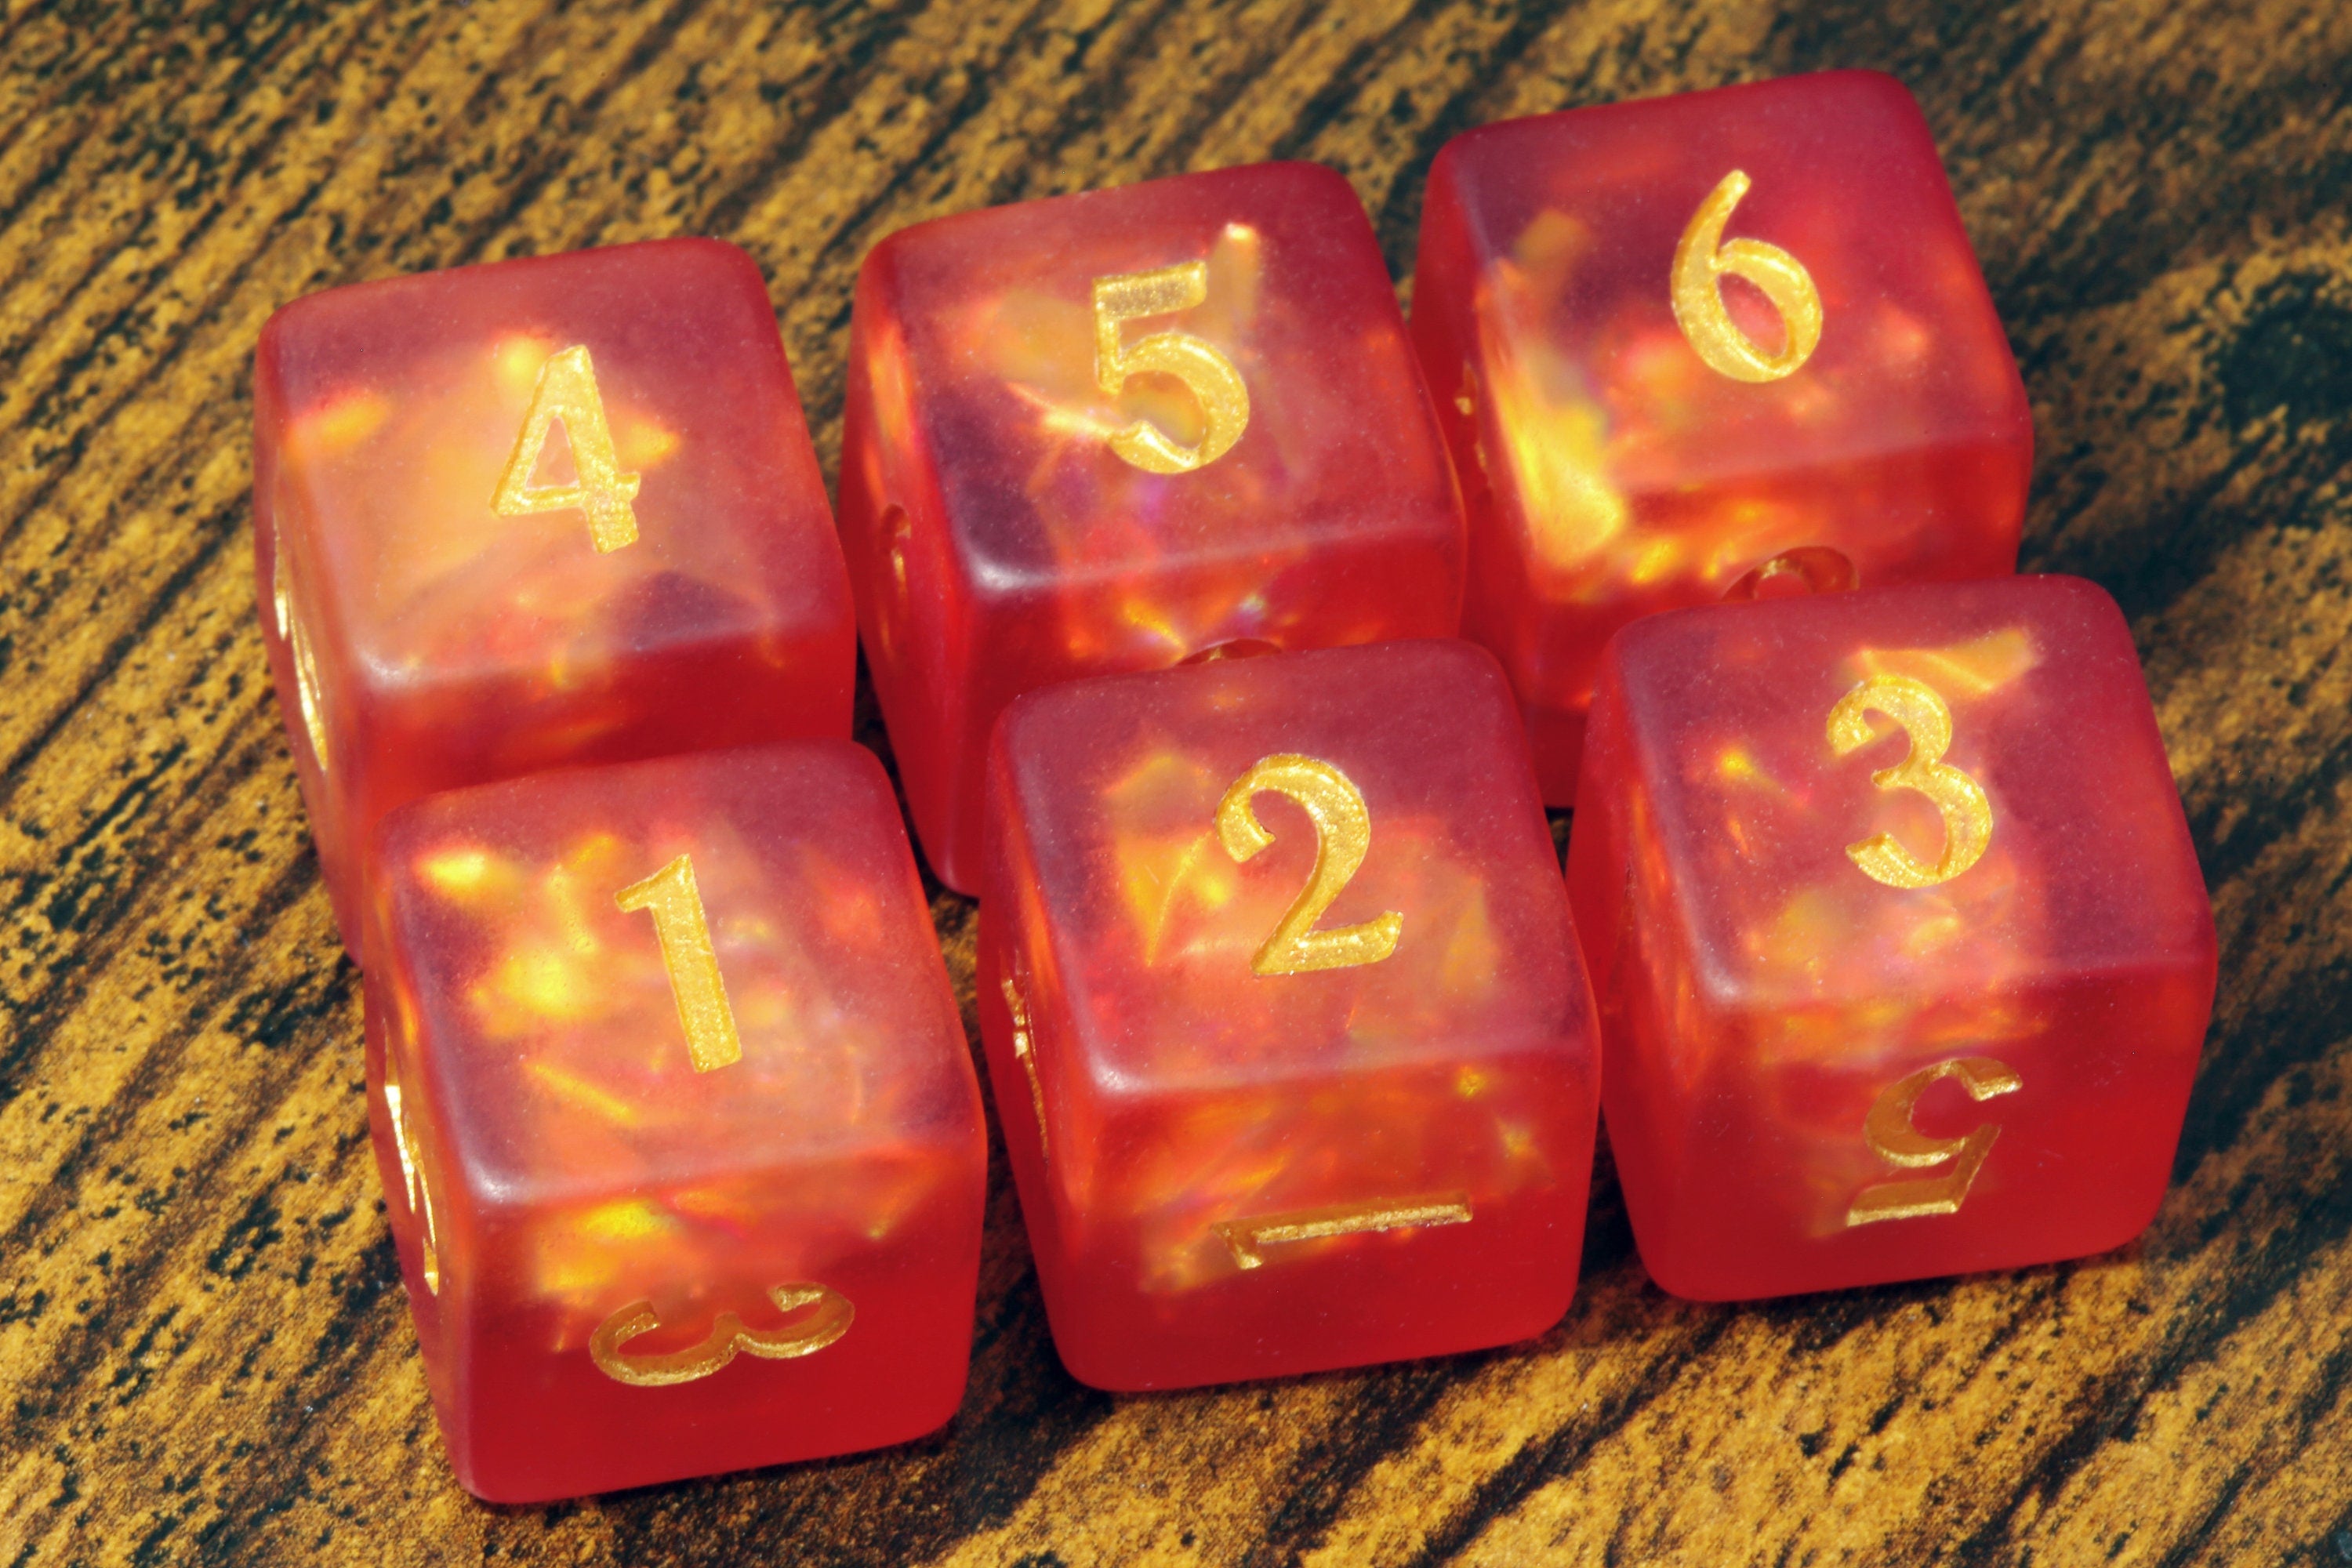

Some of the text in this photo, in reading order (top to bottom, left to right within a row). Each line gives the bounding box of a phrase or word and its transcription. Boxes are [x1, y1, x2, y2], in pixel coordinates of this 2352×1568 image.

[1093, 262, 1250, 474] 5
[1671, 170, 1823, 382] 6
[491, 345, 641, 554] 4
[1216, 753, 1403, 976] 2
[1827, 674, 1993, 888] 3
[615, 854, 742, 1073] 1
[1211, 1192, 1473, 1269] 1
[1846, 1057, 2022, 1227] 5
[590, 1282, 855, 1386] 3
